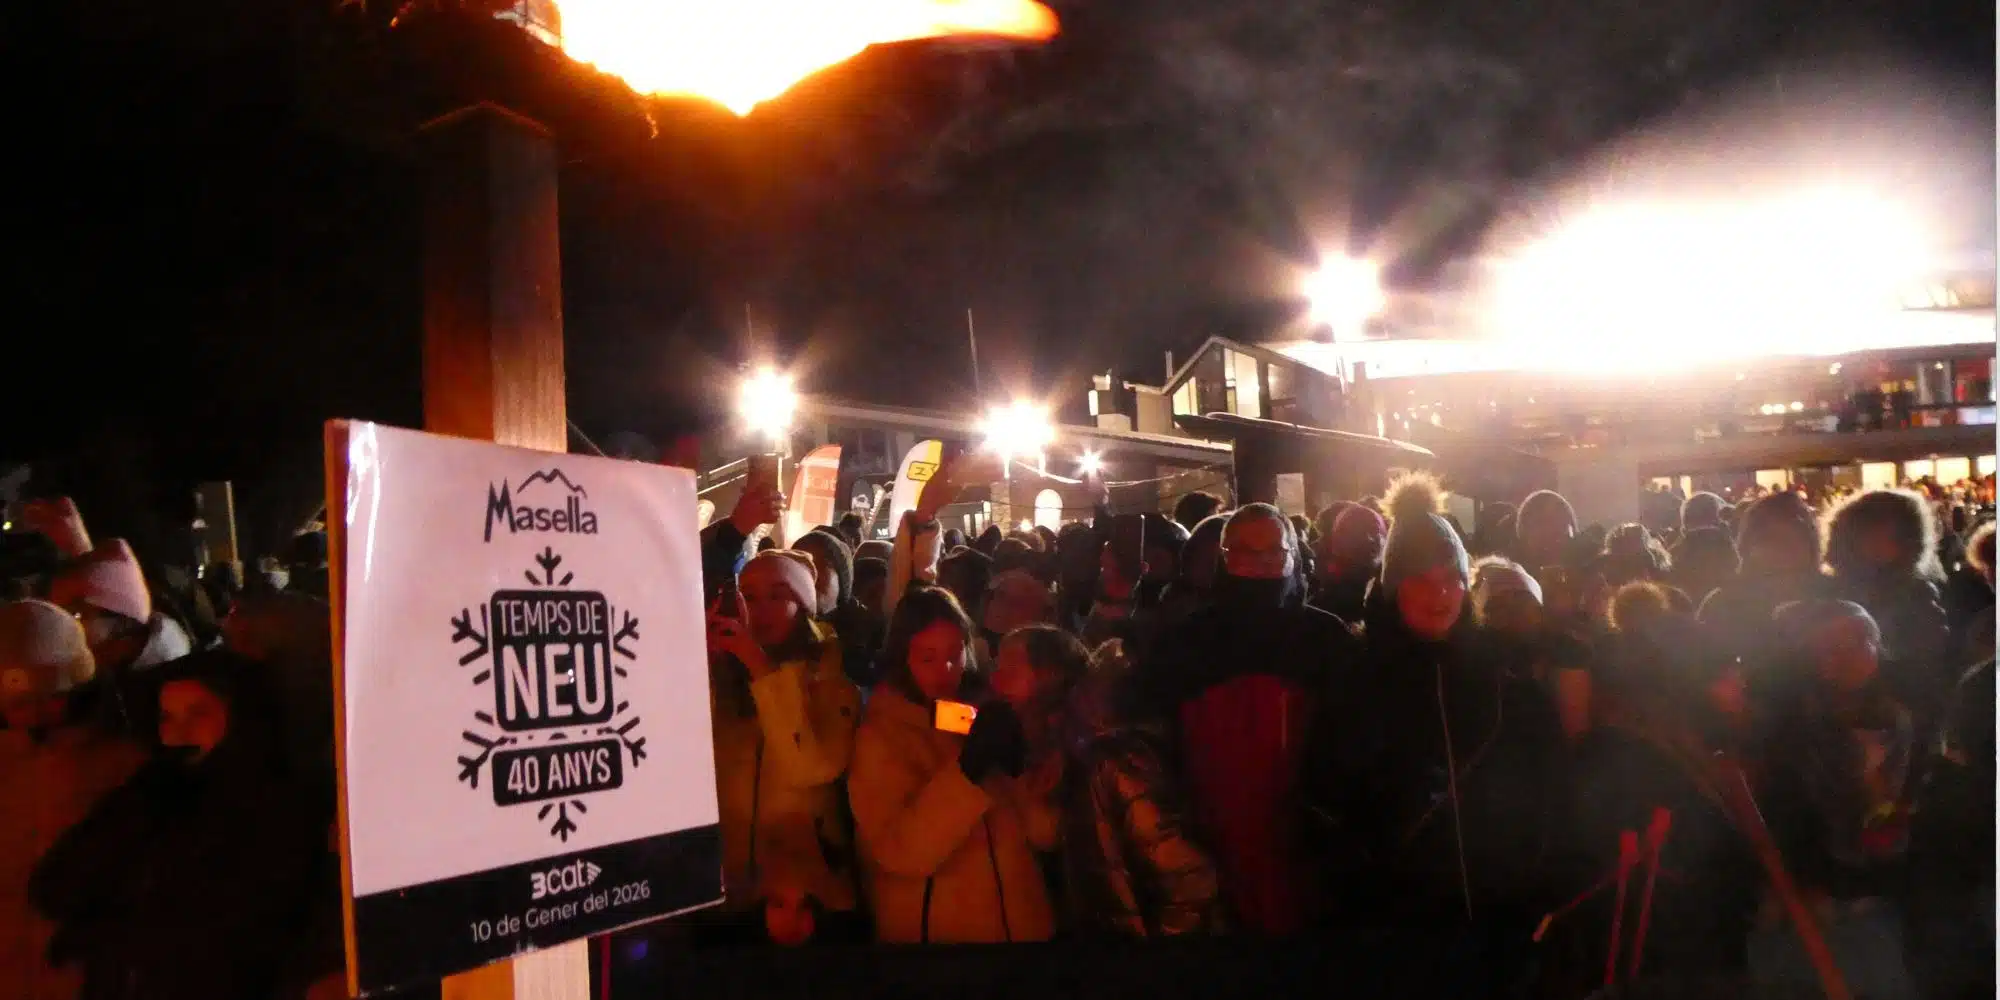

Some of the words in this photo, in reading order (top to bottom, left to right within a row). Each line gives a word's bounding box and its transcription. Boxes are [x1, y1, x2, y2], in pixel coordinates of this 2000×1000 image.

[484, 477, 598, 543] Masella
[497, 600, 571, 636] TEMPS
[577, 604, 603, 635] DE
[502, 643, 607, 721] NEU
[507, 758, 540, 795] 40
[548, 748, 611, 790] ANYS
[531, 859, 587, 900] 3cat
[471, 920, 491, 942] 10
[496, 915, 521, 936] de
[526, 901, 578, 929] Gener
[584, 893, 608, 915] del
[613, 880, 650, 907] 2026
